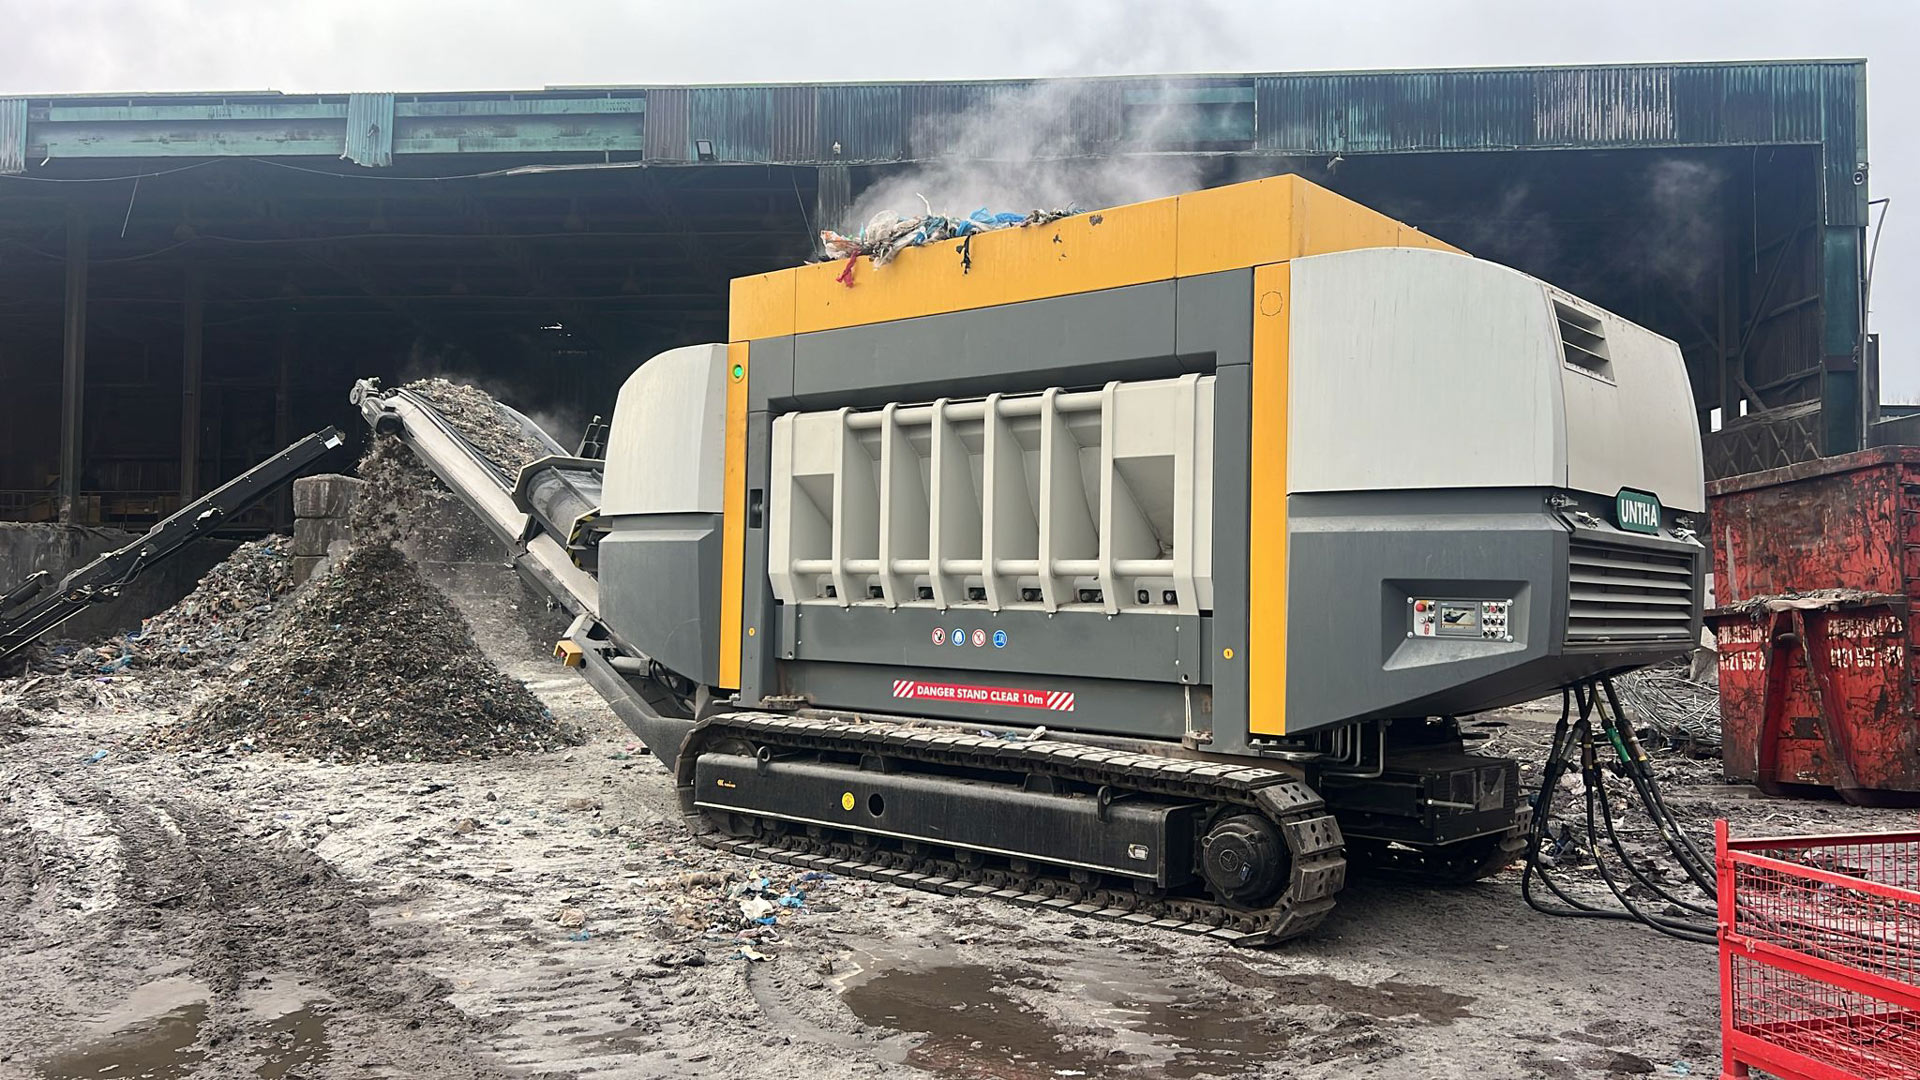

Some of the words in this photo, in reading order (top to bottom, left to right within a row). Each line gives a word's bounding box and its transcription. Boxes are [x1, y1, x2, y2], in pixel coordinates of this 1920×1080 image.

[1621, 499, 1658, 527] UNTHA
[917, 685, 955, 698] DANGER
[957, 688, 988, 700] STAND
[990, 691, 1020, 703] CLEAR
[1022, 693, 1043, 705] 10m
